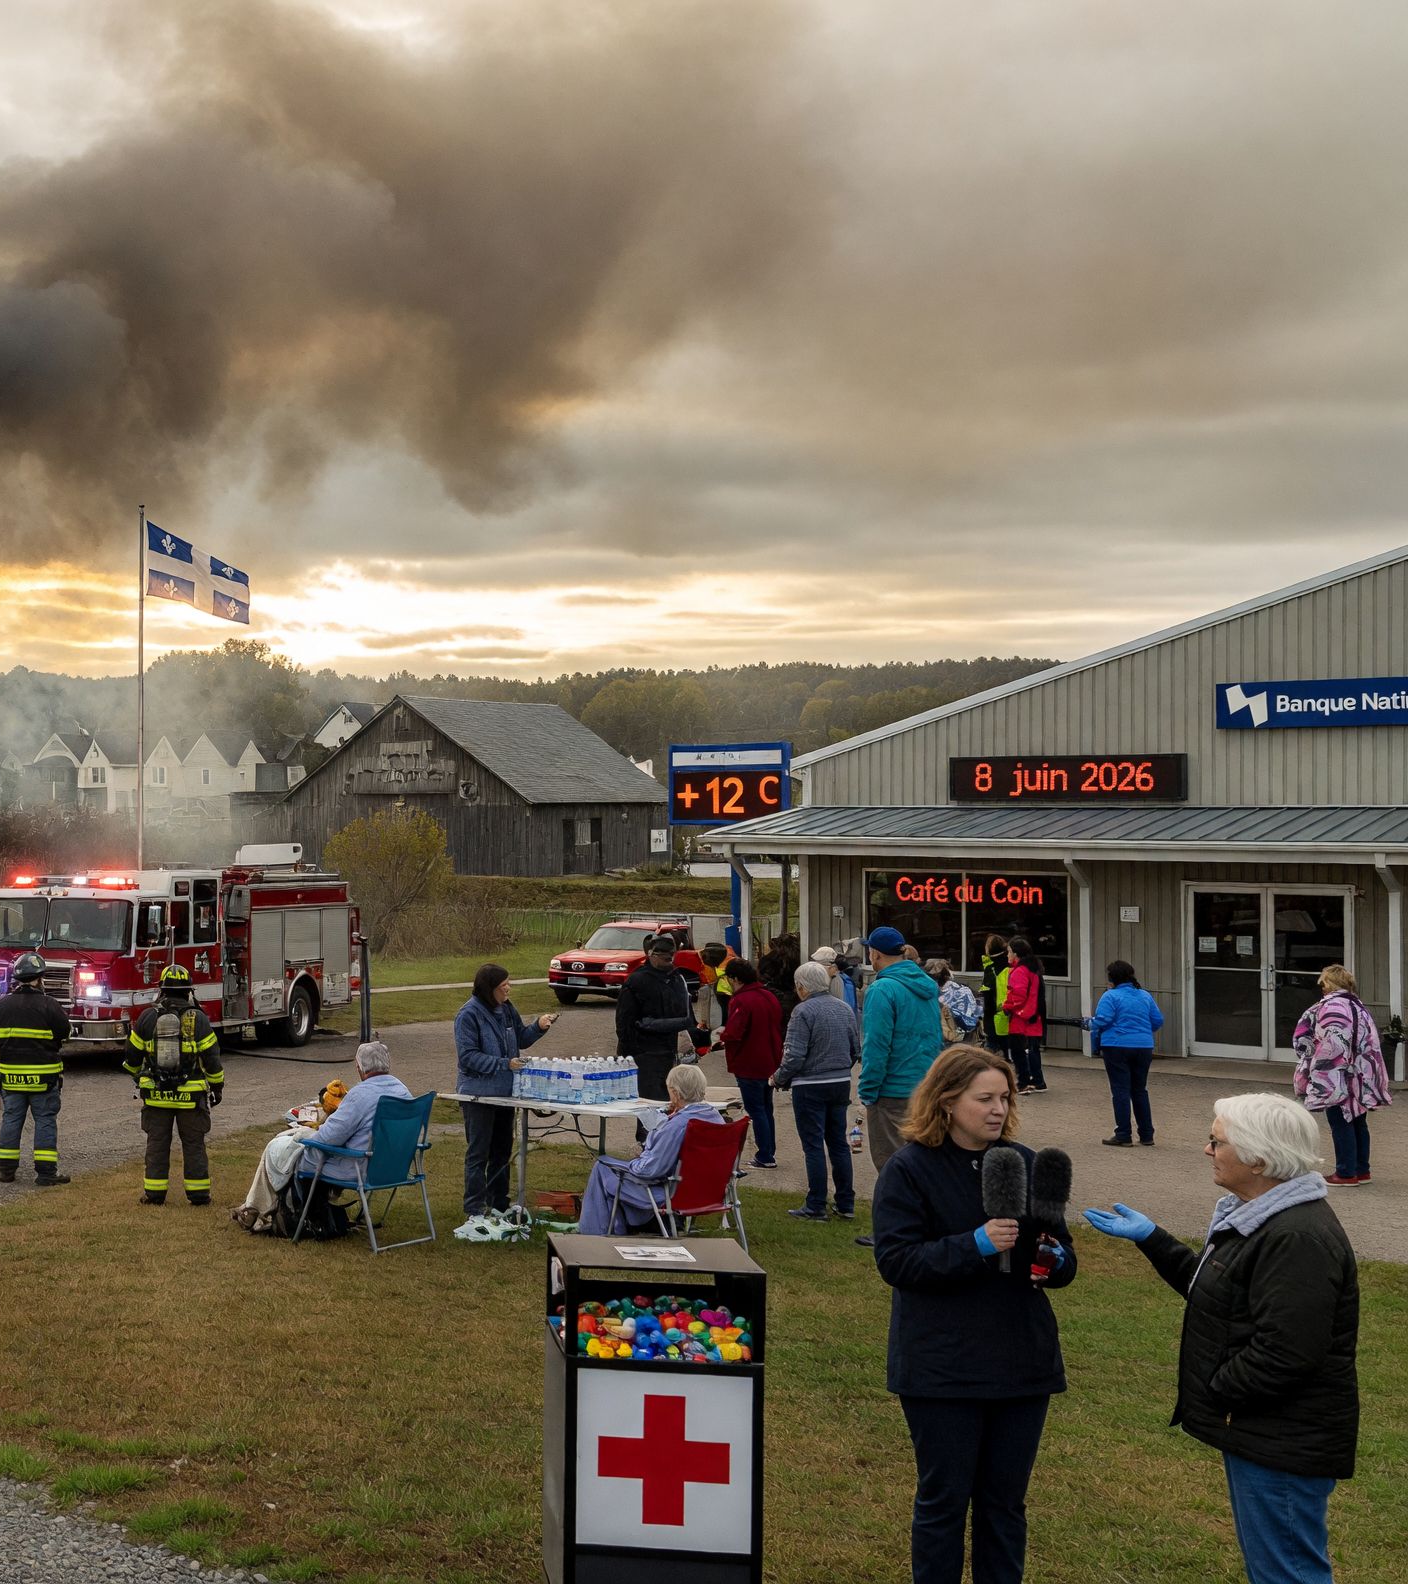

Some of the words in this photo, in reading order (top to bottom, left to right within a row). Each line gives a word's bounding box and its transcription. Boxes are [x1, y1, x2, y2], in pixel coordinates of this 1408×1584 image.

[1276, 695, 1356, 716] Banque
[1361, 691, 1408, 710] Nati
[759, 776, 779, 804] C
[975, 763, 991, 792] 8
[1009, 763, 1067, 796] juin
[1080, 762, 1154, 792] 2026
[896, 876, 948, 903] Café
[955, 879, 983, 903] du
[992, 878, 1044, 904] Coin
